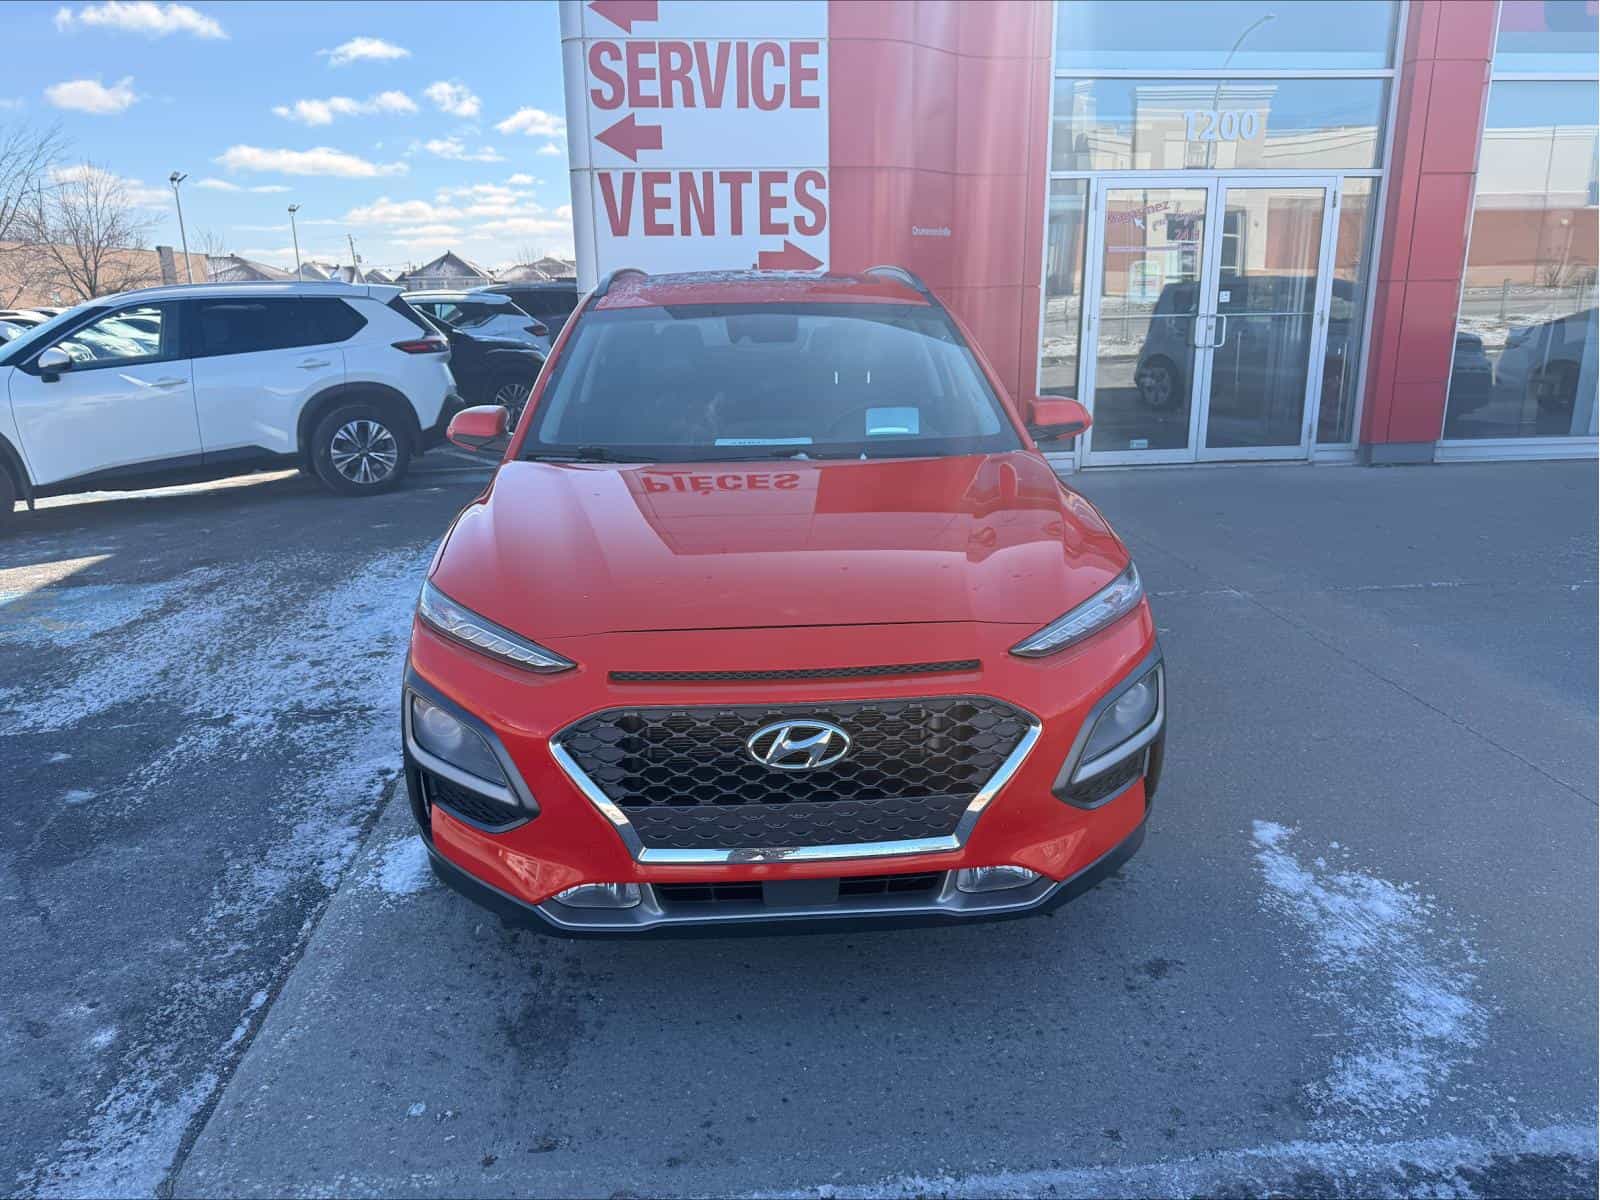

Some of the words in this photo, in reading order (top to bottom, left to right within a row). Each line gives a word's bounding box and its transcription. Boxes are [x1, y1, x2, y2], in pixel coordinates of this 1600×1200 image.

[588, 40, 821, 111] SERVICE
[1184, 110, 1261, 142] 1200
[597, 170, 827, 237] VENTES
